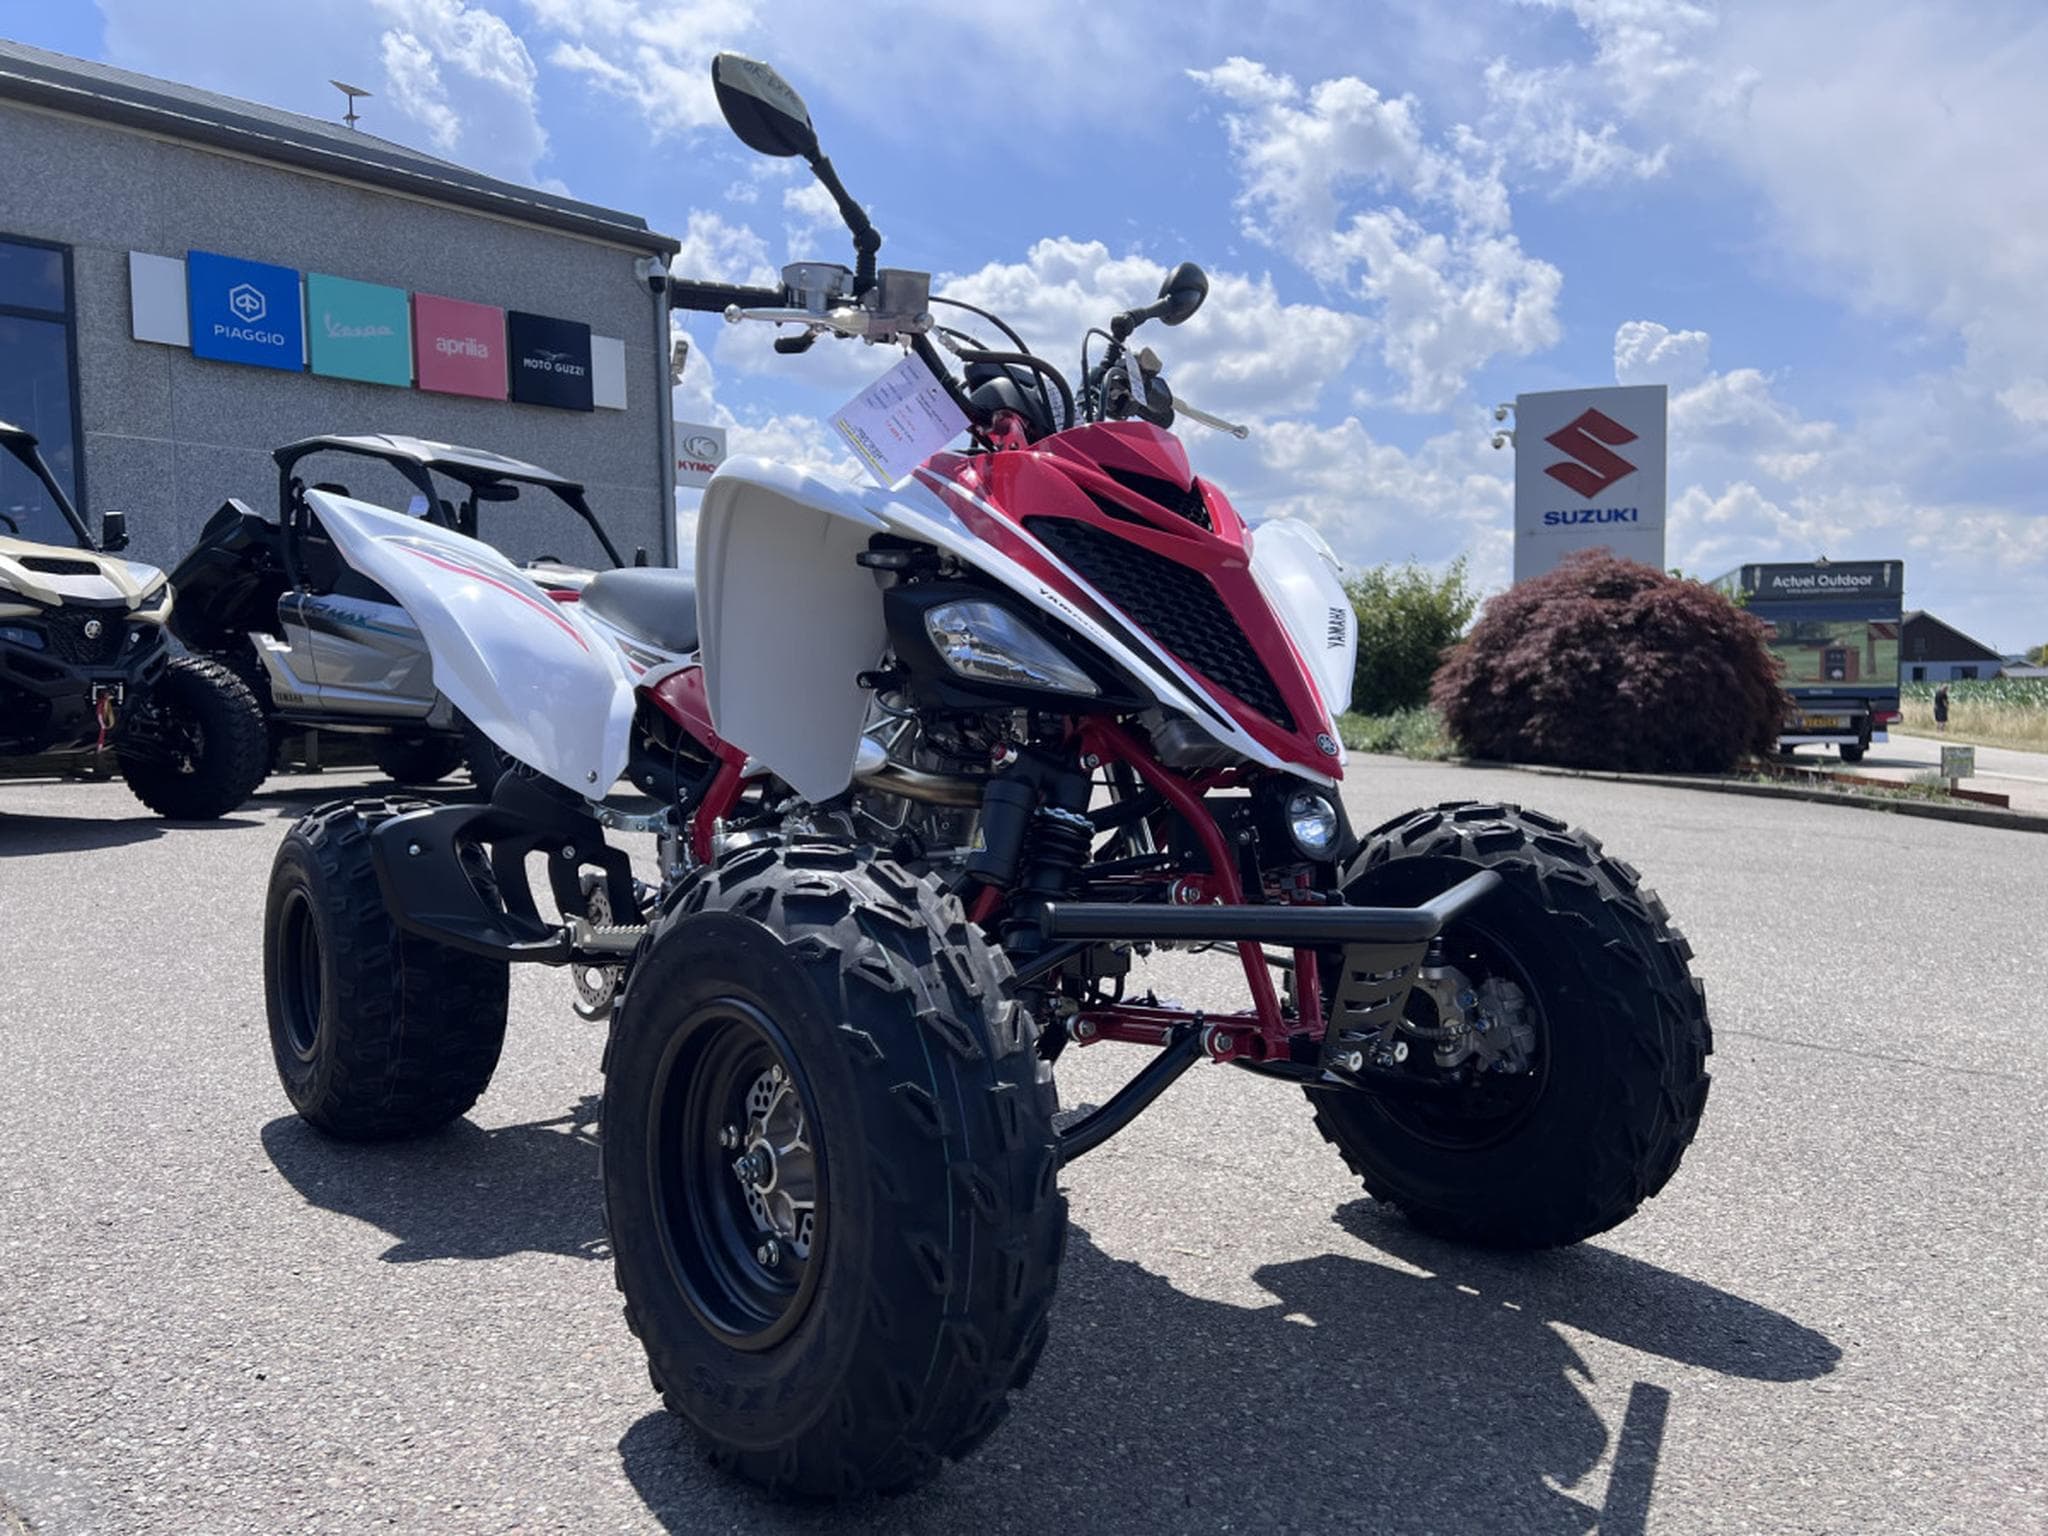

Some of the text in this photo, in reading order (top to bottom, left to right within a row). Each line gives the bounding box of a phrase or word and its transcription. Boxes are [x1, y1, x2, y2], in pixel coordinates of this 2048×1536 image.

[323, 309, 395, 337] Vespa
[213, 324, 285, 346] PIAGGIO
[436, 336, 489, 359] aprilia
[523, 357, 585, 376] MOTO GUZZI
[678, 459, 719, 474] KYMC
[1543, 507, 1638, 526] SUZUKI
[1772, 573, 1873, 588] Actuel Outdoor
[1327, 606, 1346, 650] YAMAHA
